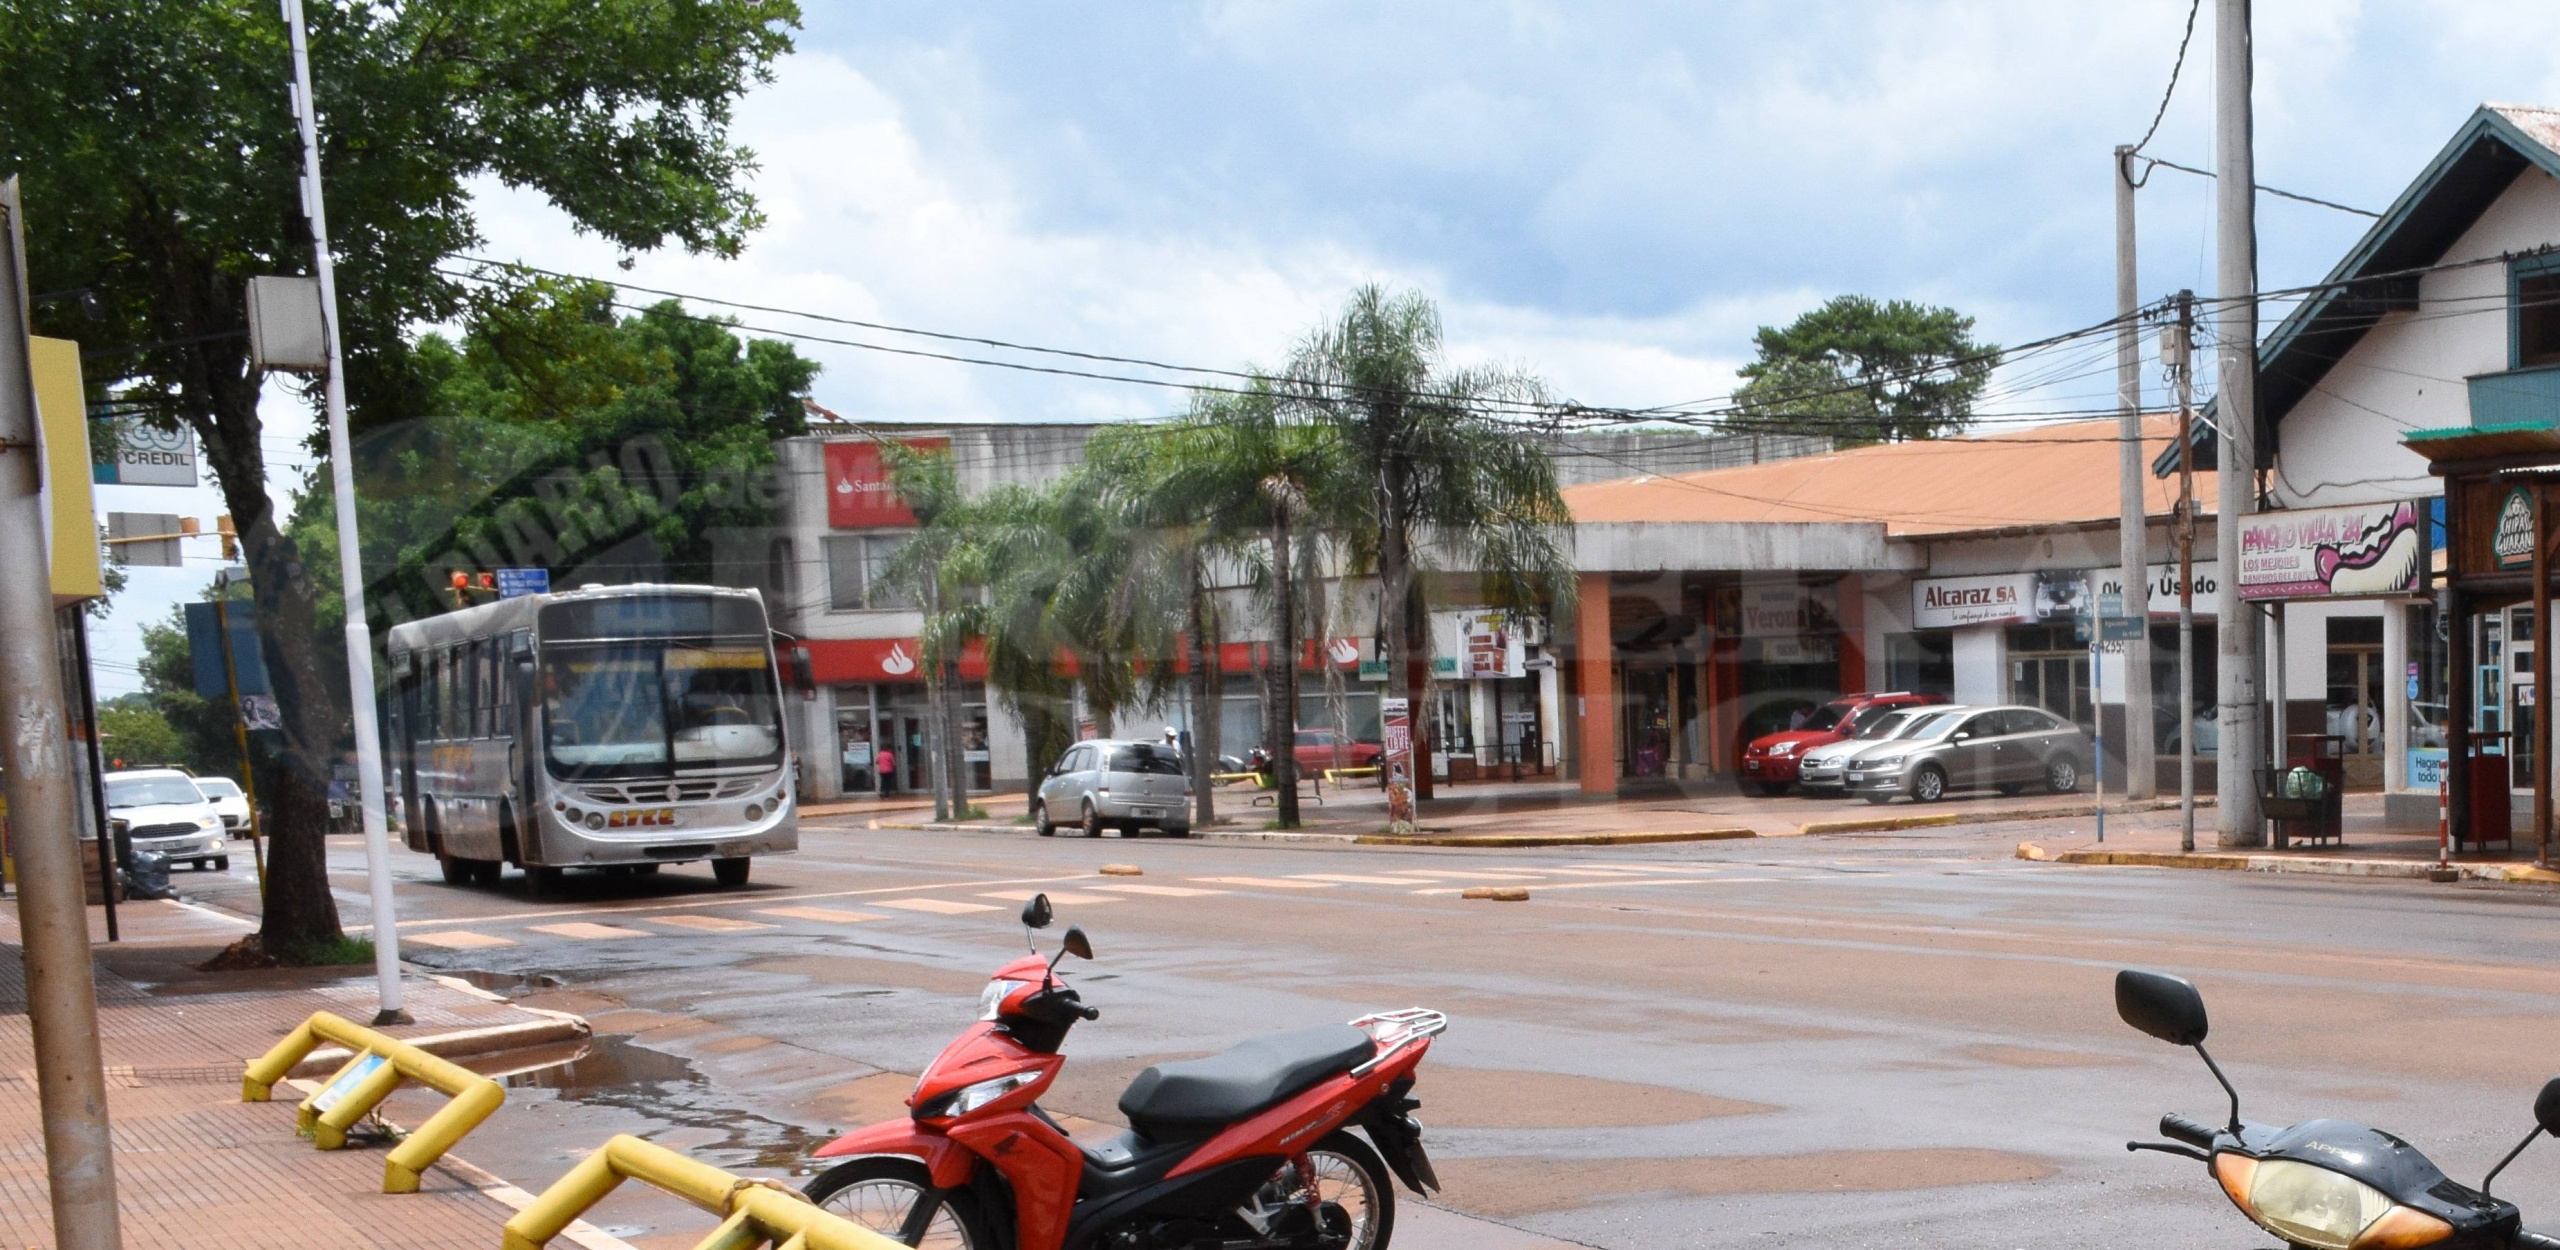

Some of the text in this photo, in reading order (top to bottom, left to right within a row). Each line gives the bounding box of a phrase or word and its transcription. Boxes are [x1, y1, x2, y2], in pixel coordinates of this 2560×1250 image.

[125, 452, 189, 467] CREDIL
[2299, 515, 2340, 550] VILLA
[2243, 556, 2300, 572] LOS MEJORES
[1925, 585, 2017, 608] Alcaraz SA
[1746, 607, 1807, 631] Verona
[1386, 738, 1409, 750] LIBRE
[2418, 772, 2438, 782] todo
